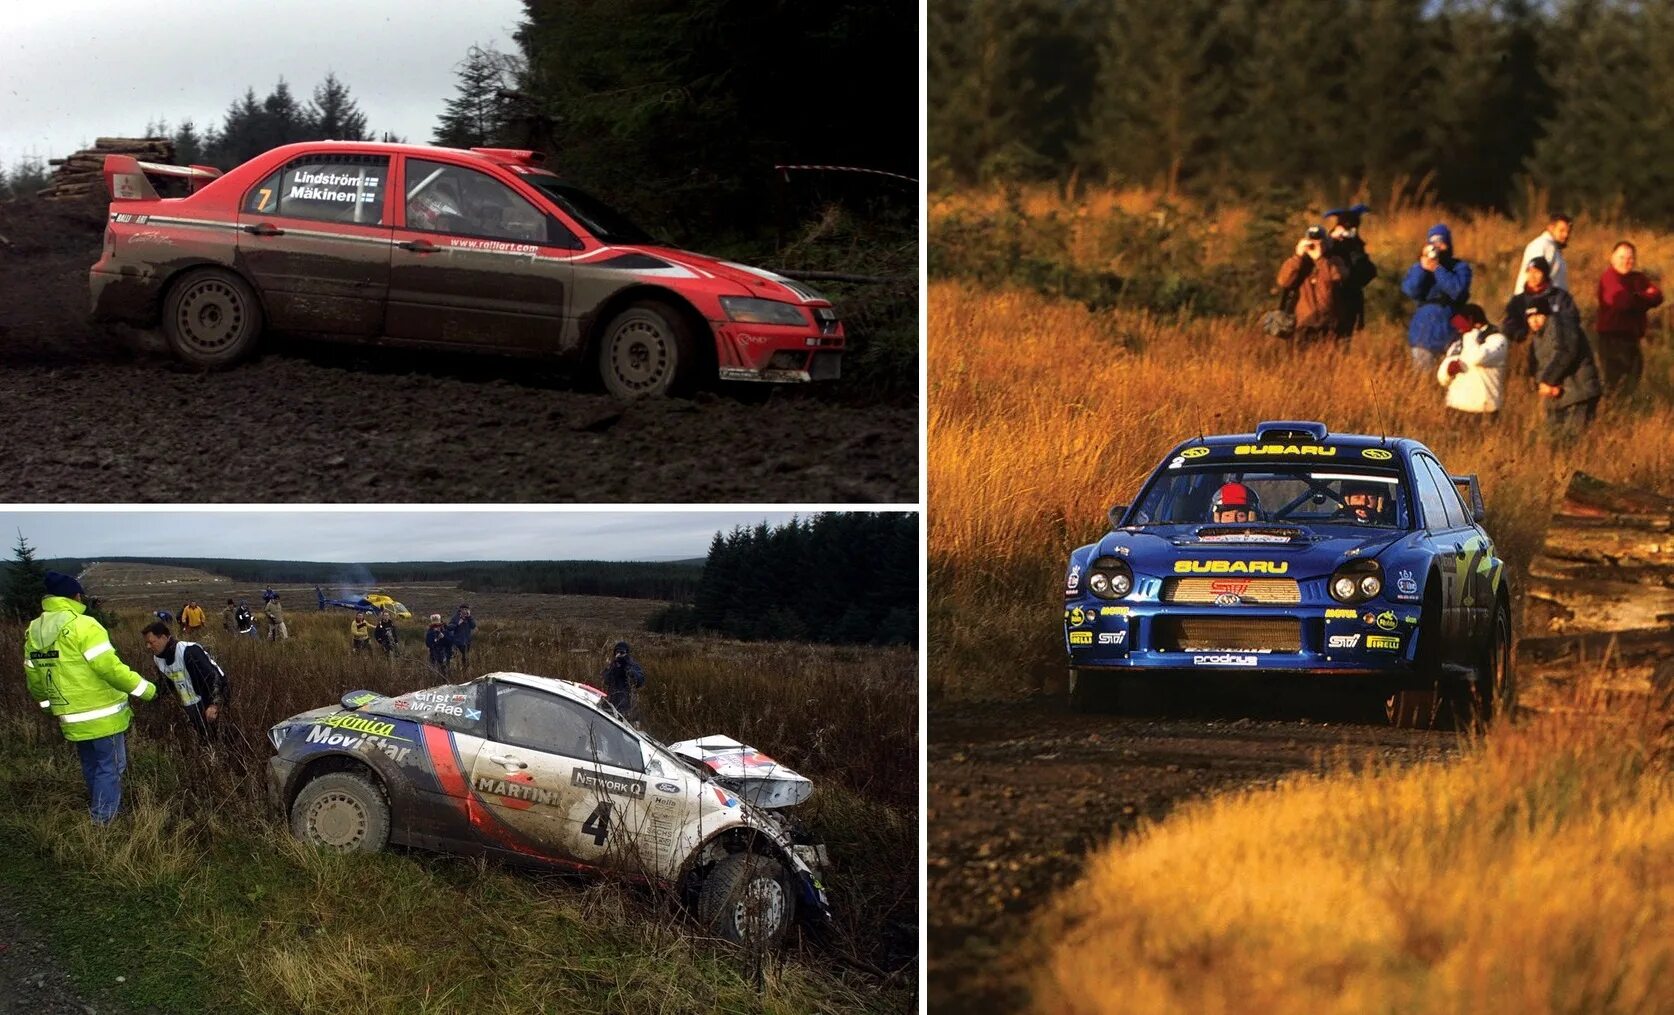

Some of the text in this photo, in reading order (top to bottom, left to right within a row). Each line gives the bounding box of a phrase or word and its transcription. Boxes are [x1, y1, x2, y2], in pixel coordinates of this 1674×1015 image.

[294, 171, 361, 187] Lindström
[257, 188, 272, 211] 7
[290, 186, 356, 203] Mäkinen
[450, 239, 539, 253] www.ralliart.com
[1234, 445, 1337, 456] SUBARU
[1168, 456, 1186, 470] 2
[1173, 560, 1289, 574] SUBARU
[1366, 634, 1401, 649] PIRELLI
[1193, 653, 1258, 667] prodrive
[305, 724, 412, 762] MoviStar
[478, 777, 562, 805] MARTINI
[575, 771, 642, 796] NETWORK Q
[581, 800, 615, 847] 4
